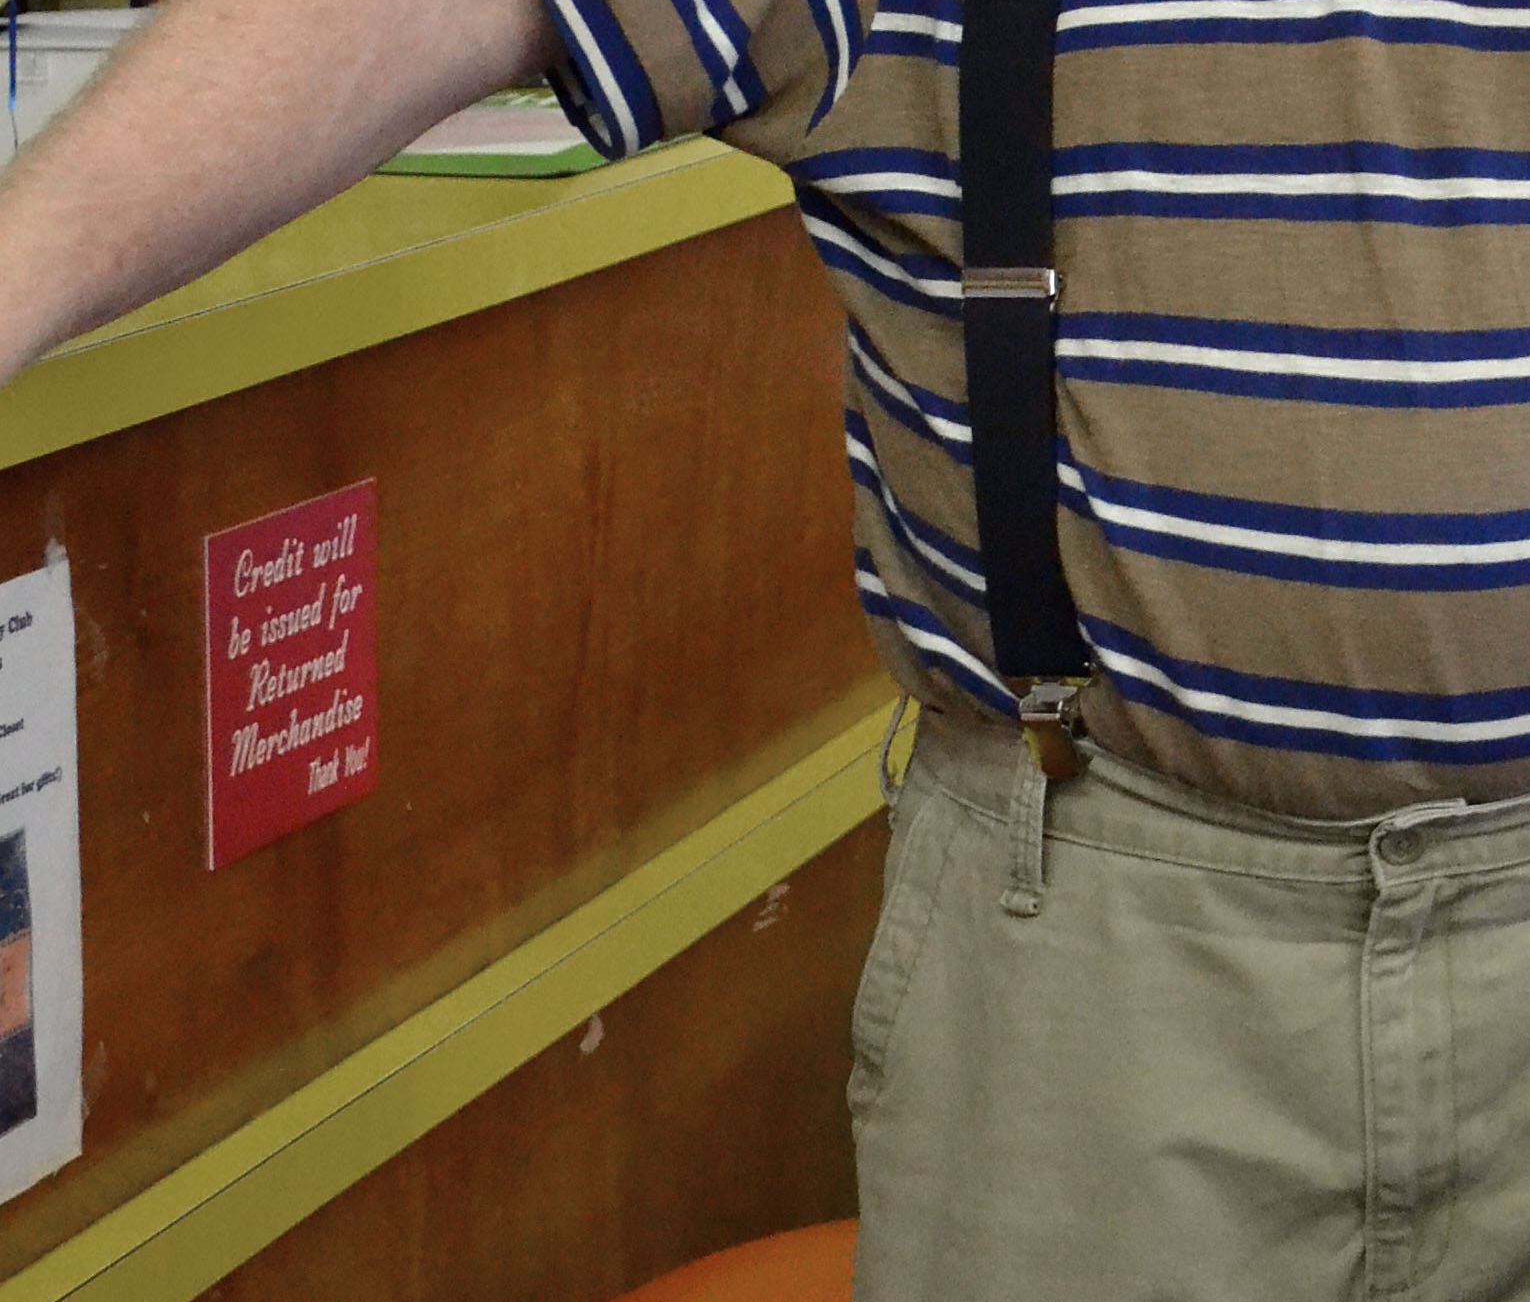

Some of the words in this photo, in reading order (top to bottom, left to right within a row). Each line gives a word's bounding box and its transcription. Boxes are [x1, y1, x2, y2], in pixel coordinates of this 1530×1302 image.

[234, 538, 304, 598] Credit
[313, 513, 358, 568] will
[228, 616, 252, 660] be
[260, 582, 327, 647] issued
[328, 573, 363, 630] for
[246, 628, 349, 712] Returned
[230, 689, 363, 777] Merchandise
[307, 748, 340, 795] Thank
